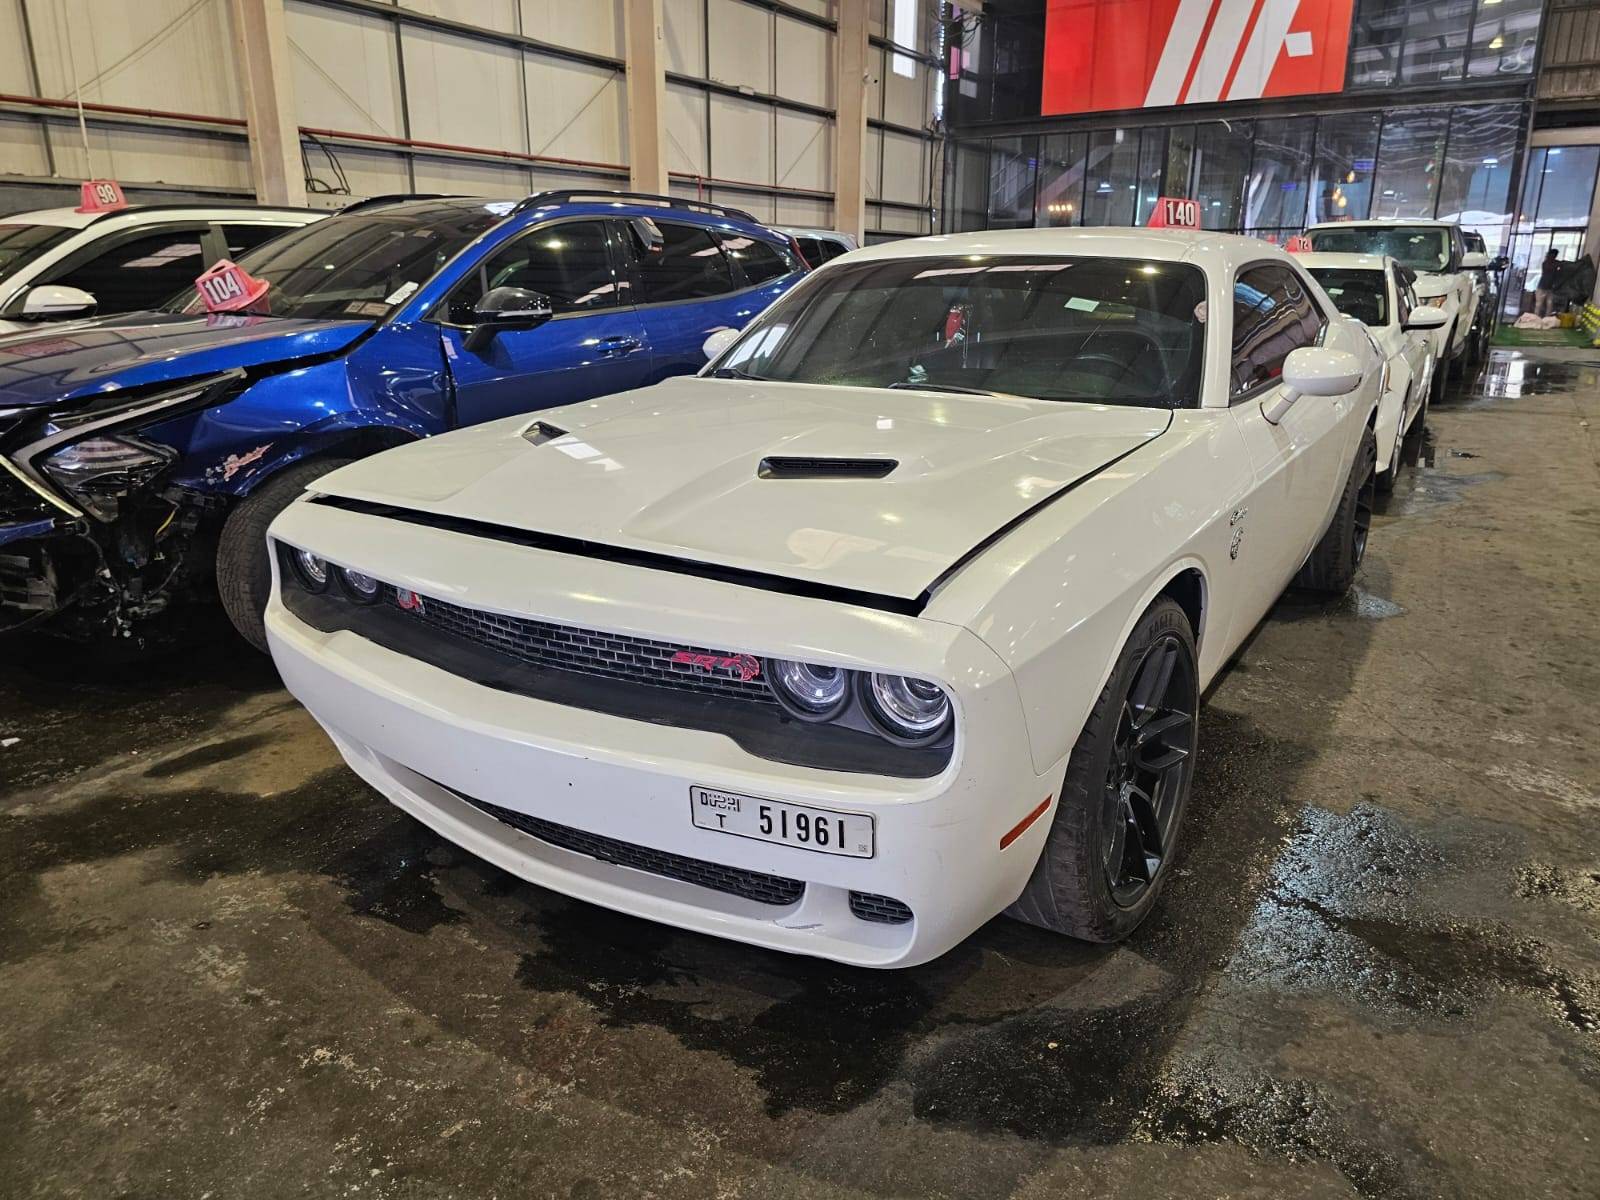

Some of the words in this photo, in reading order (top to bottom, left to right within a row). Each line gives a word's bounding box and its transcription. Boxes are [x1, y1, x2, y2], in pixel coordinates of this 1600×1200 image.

[96, 184, 118, 203] 98
[1167, 201, 1195, 226] 140
[205, 272, 242, 304] 104
[715, 813, 727, 828] T
[759, 805, 845, 849] 51961
